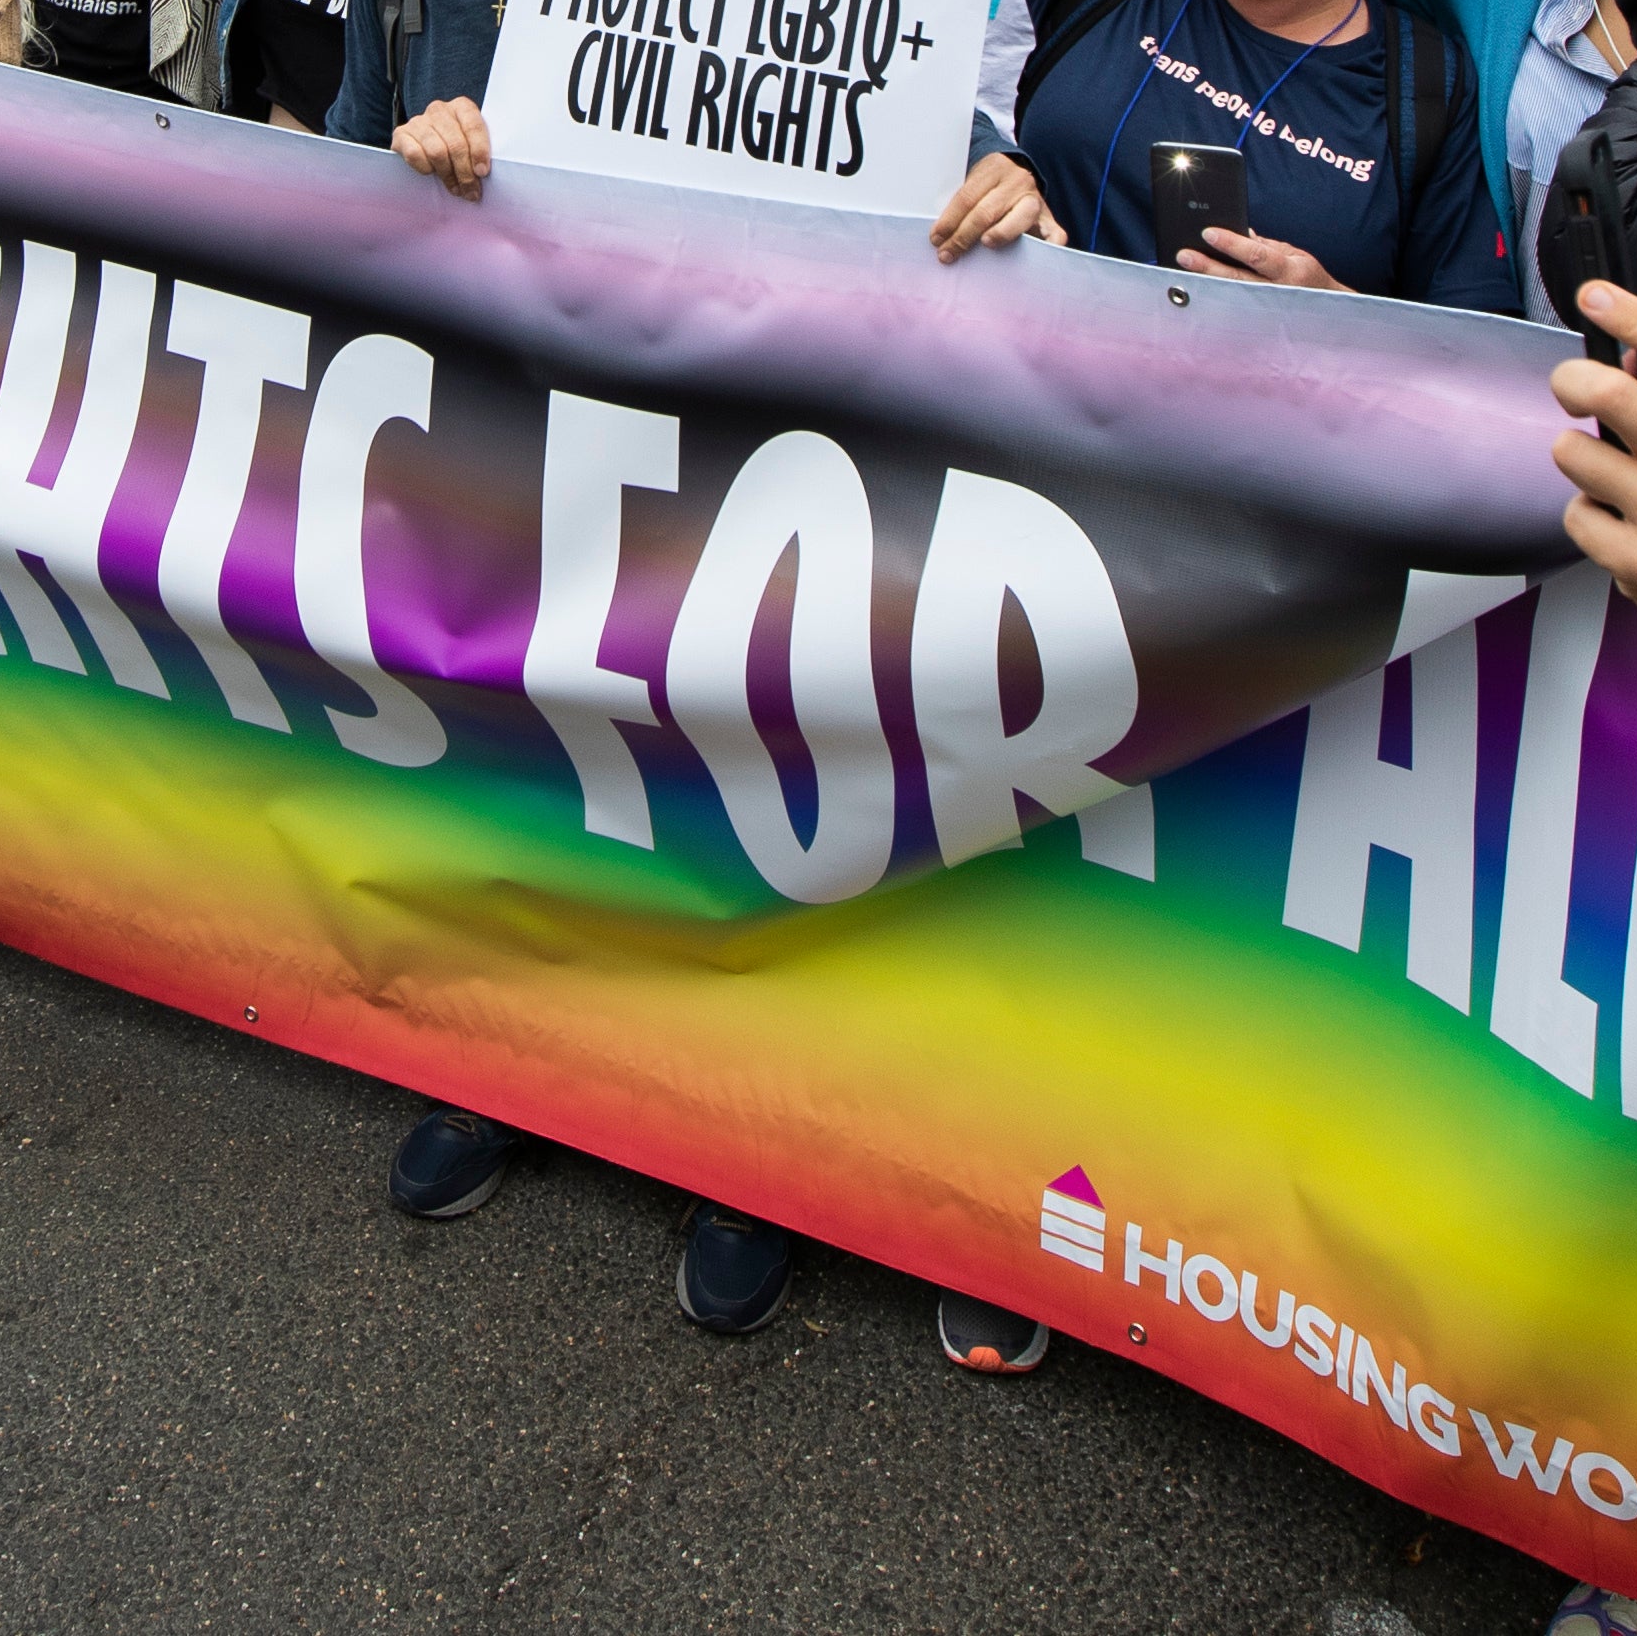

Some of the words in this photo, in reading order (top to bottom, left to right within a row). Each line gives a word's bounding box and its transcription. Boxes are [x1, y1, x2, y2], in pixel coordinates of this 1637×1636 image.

[567, 30, 675, 141] CIVIL
[686, 53, 873, 177] RIGHTS
[1139, 35, 1200, 83] trans
[1194, 80, 1277, 136] people
[1278, 124, 1376, 182] belong
[524, 390, 1157, 904] FOR
[1124, 1221, 1462, 1457] HOUSING
